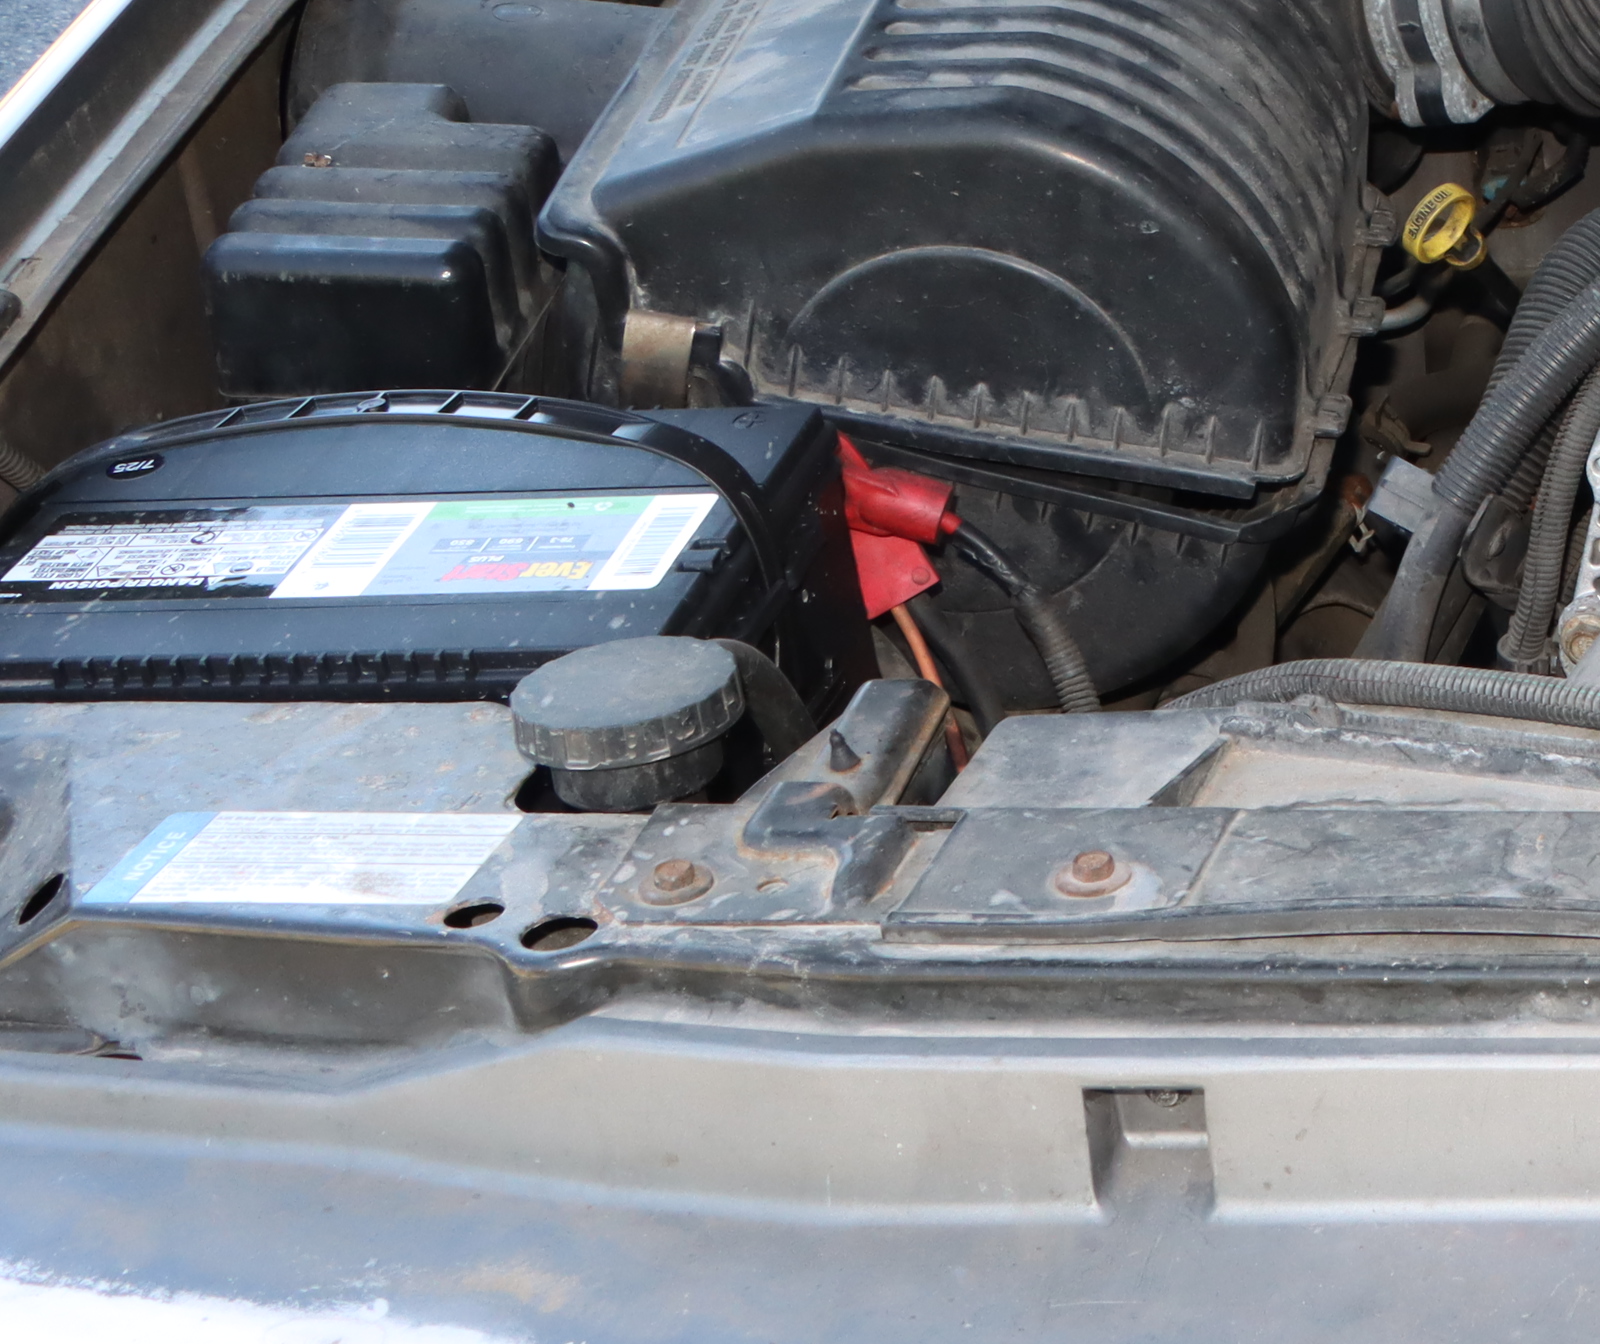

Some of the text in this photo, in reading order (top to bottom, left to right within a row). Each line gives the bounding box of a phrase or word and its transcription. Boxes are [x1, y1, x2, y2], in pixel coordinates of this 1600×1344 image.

[1408, 189, 1453, 239] ENGINE OIL
[113, 459, 155, 474] 7/25
[466, 554, 505, 563] PLUS
[439, 560, 593, 582] EverStart
[48, 577, 204, 589] DANGER/POISON
[122, 830, 187, 881] NOTICE
